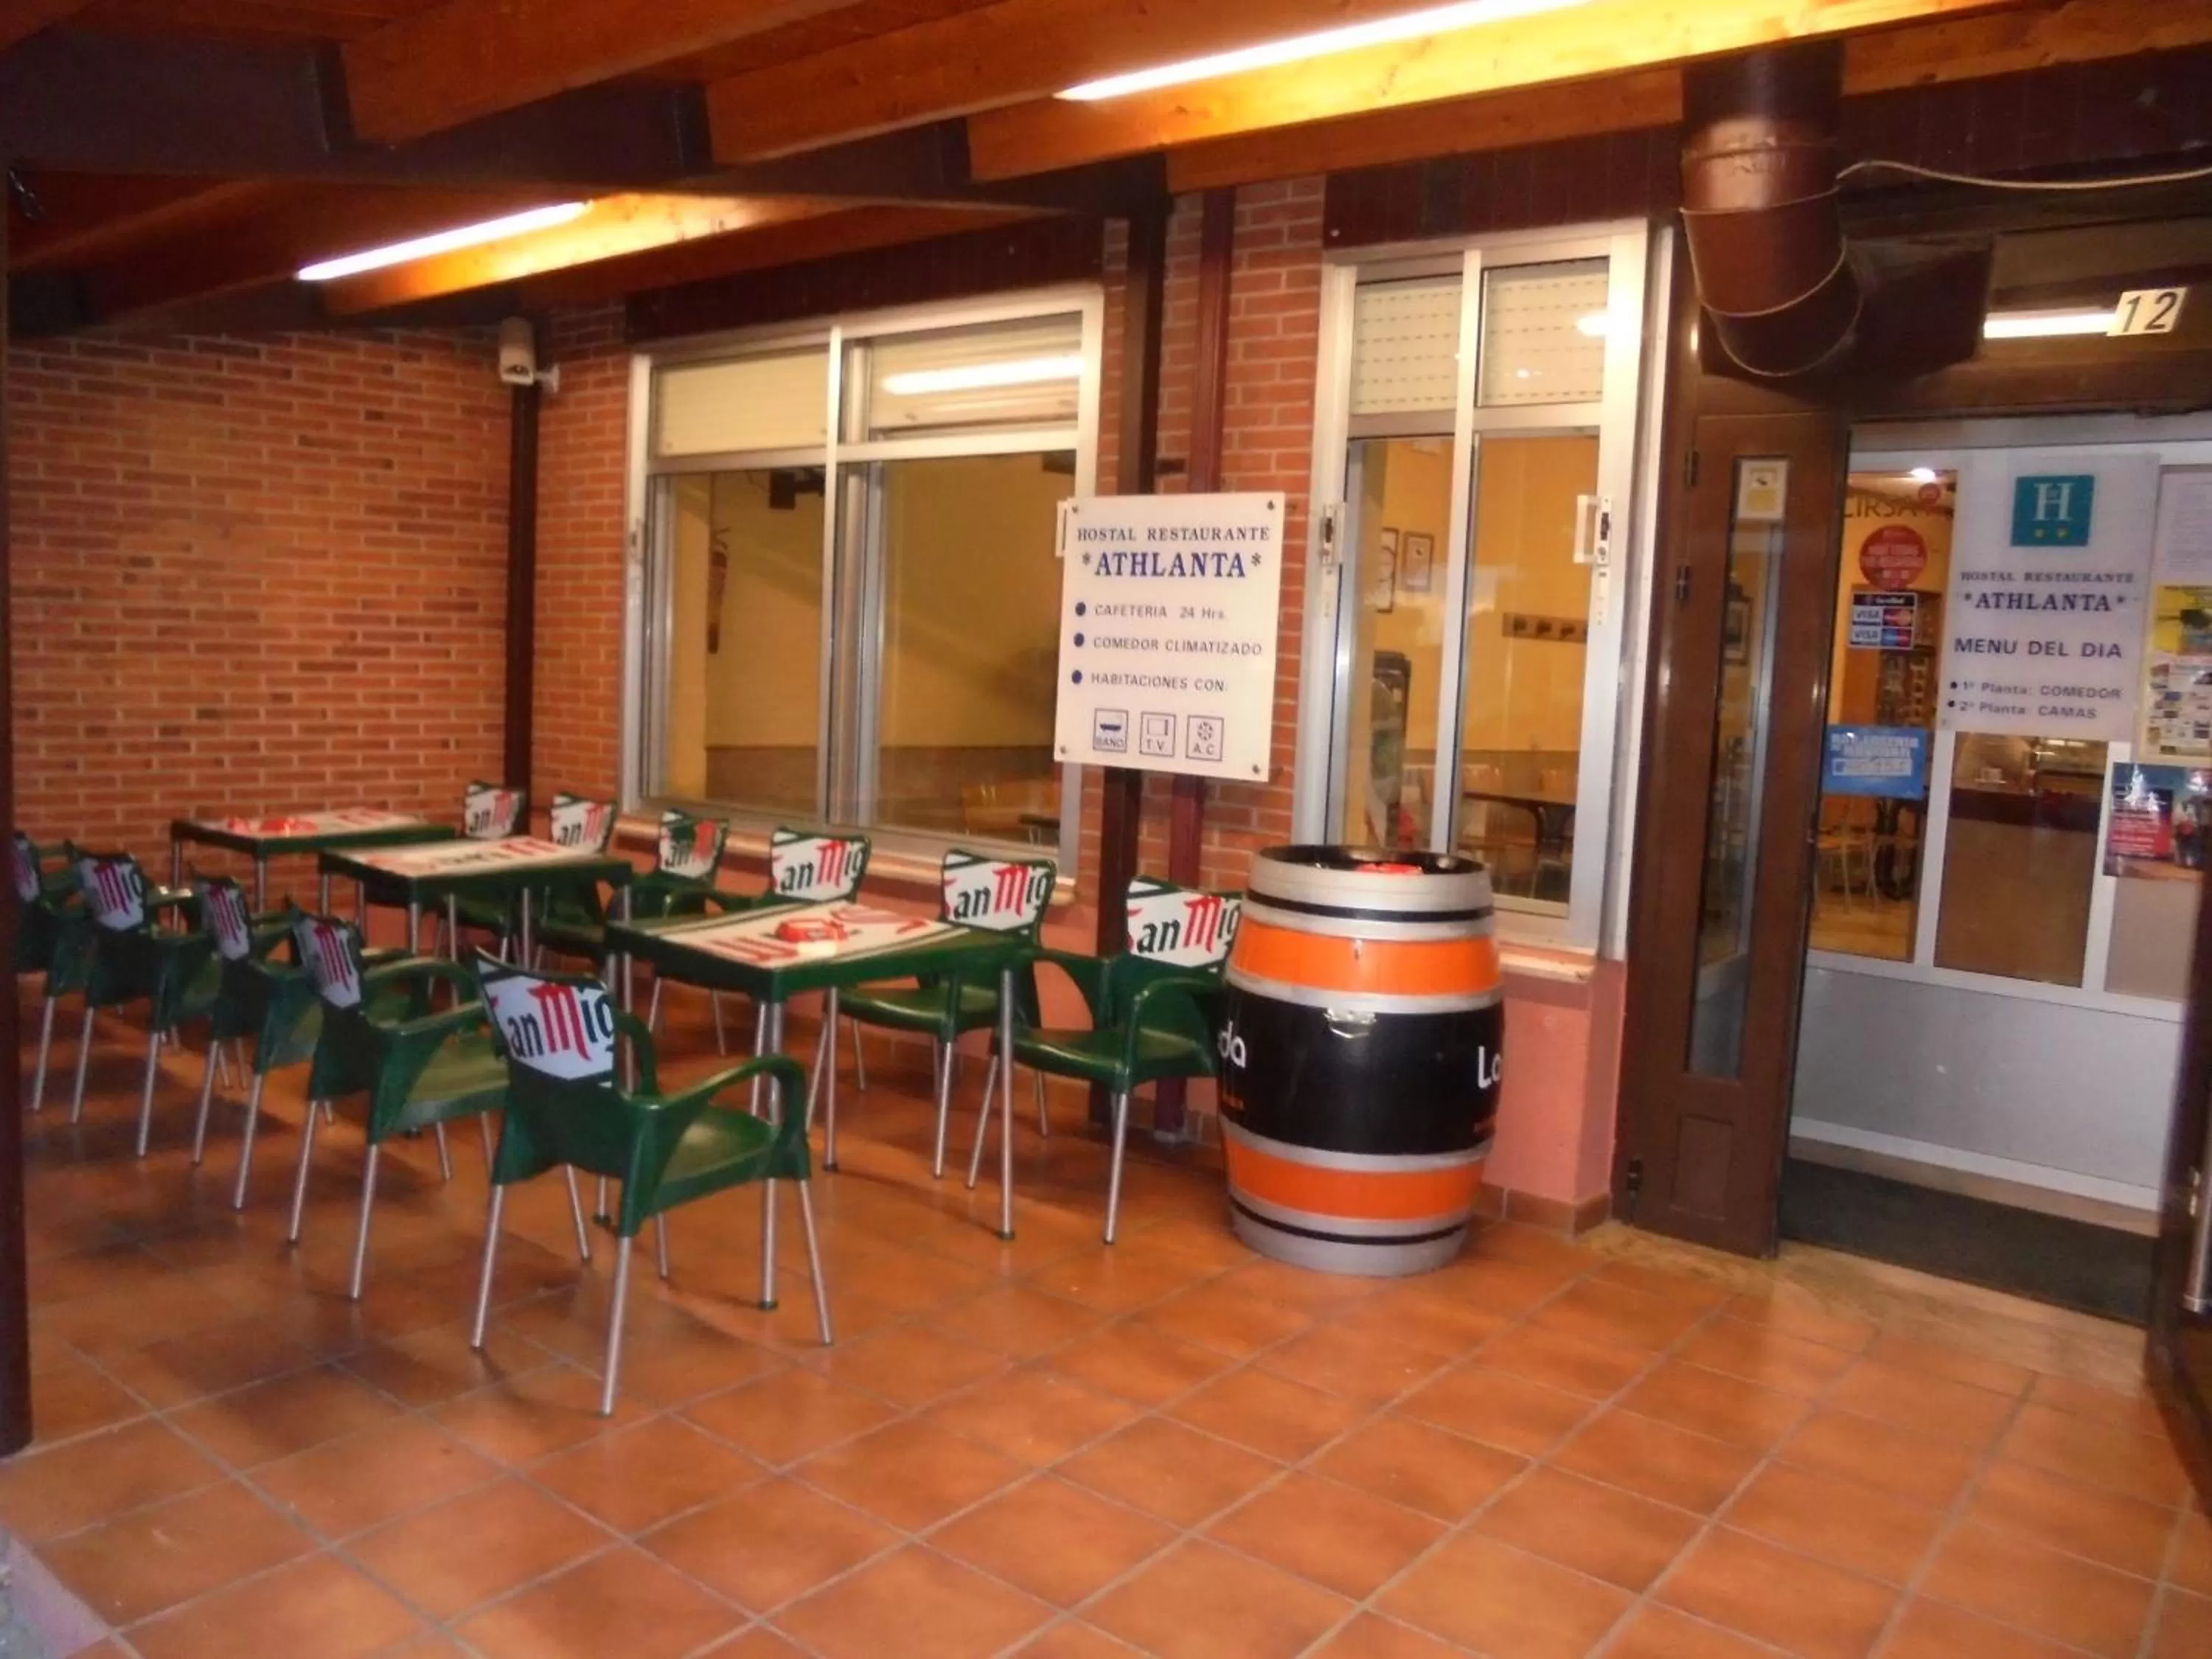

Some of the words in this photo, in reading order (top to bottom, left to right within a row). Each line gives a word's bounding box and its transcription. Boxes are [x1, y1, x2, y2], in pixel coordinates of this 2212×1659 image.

[2122, 292, 2177, 333] 12
[2033, 482, 2075, 521] H
[1077, 527, 1137, 542] HOSTAL
[1147, 526, 1270, 541] RESTAURANTE
[1961, 571, 2015, 582] HOSTAL
[2024, 572, 2135, 583] RESTAURANTE
[1095, 604, 1167, 618] CAFETERIA
[1179, 606, 1194, 619] 24
[1093, 637, 1158, 651] COMEDOR
[1165, 639, 1262, 655] CLIMATIZADO
[1954, 638, 2017, 654] MENU
[2028, 641, 2070, 656] DEL
[2081, 642, 2122, 658] DIA
[1091, 672, 1188, 689] HABITACIONES
[2040, 685, 2124, 700] COMEDOR
[2038, 706, 2098, 719] CAMAS
